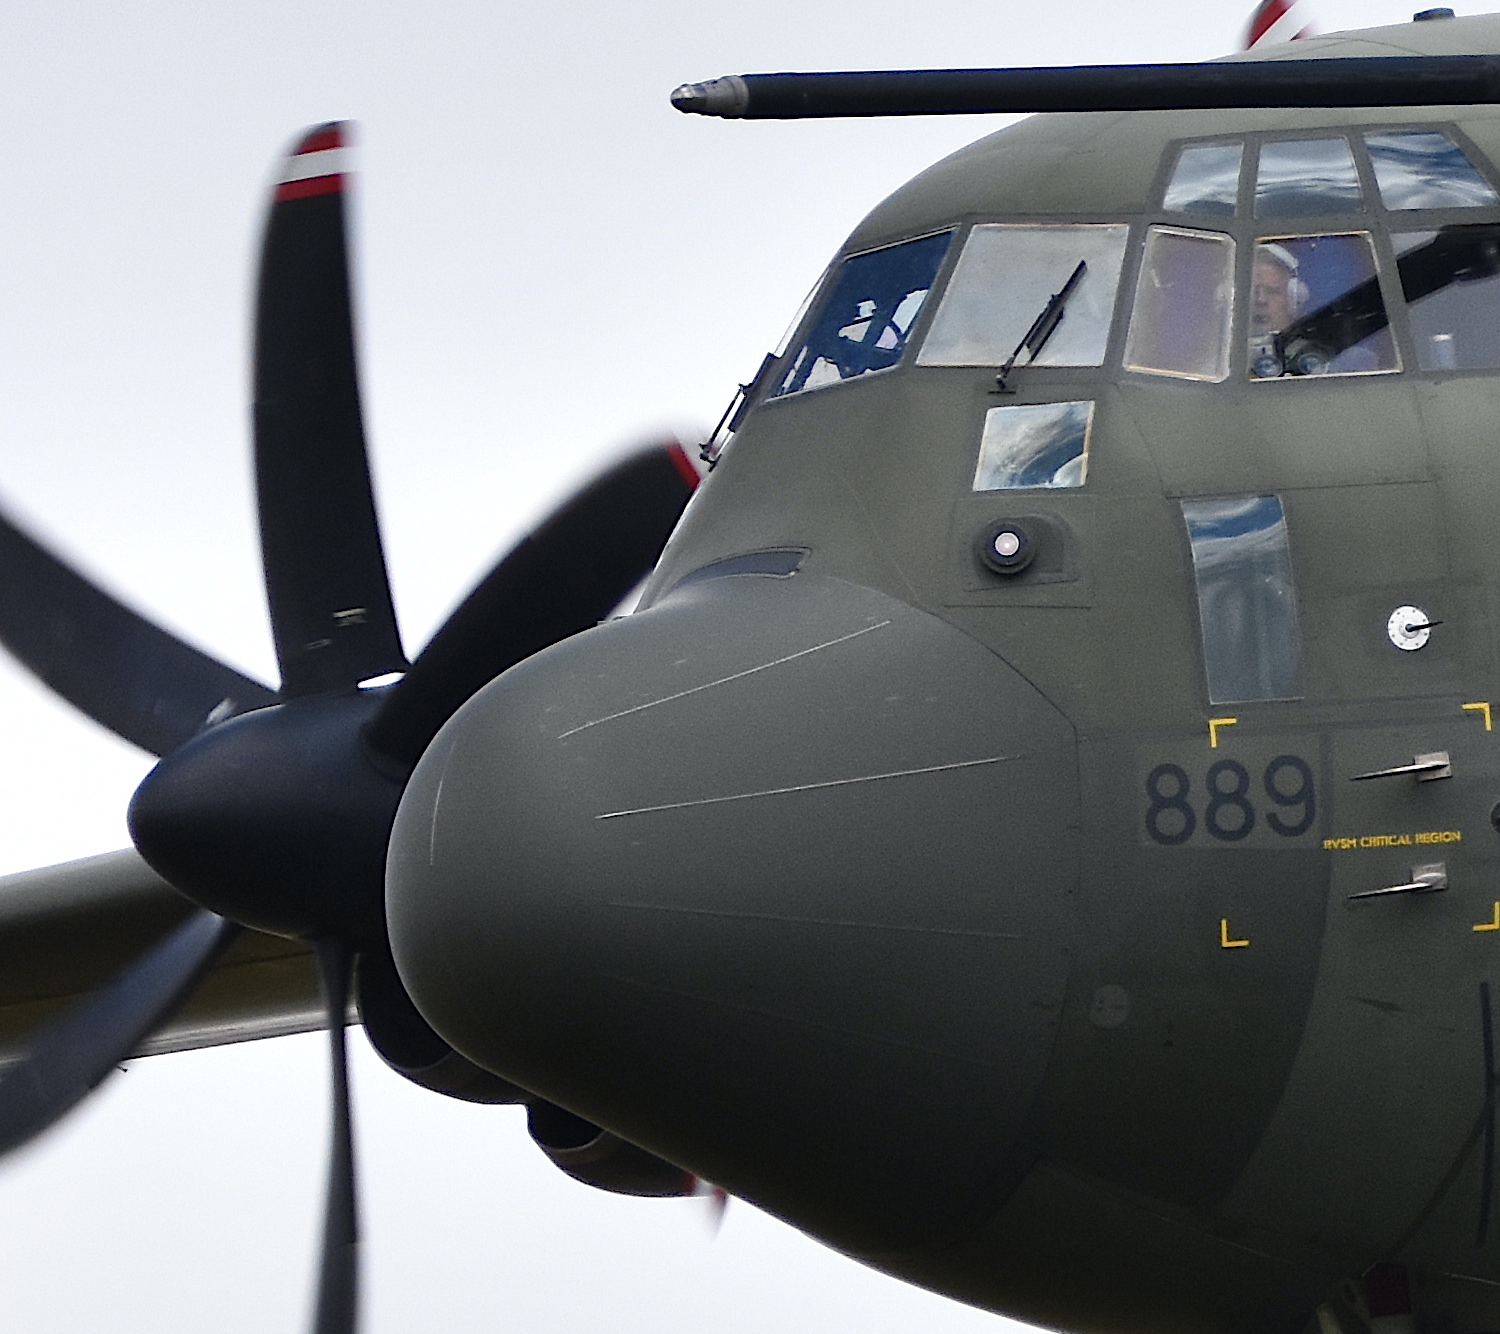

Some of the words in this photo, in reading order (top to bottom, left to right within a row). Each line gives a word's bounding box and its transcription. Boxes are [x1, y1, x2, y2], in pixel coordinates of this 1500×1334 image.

[1145, 754, 1317, 846] 889
[1323, 837, 1357, 850] RVSM
[1360, 833, 1412, 848] CRITICAL
[1415, 830, 1462, 844] REGION
